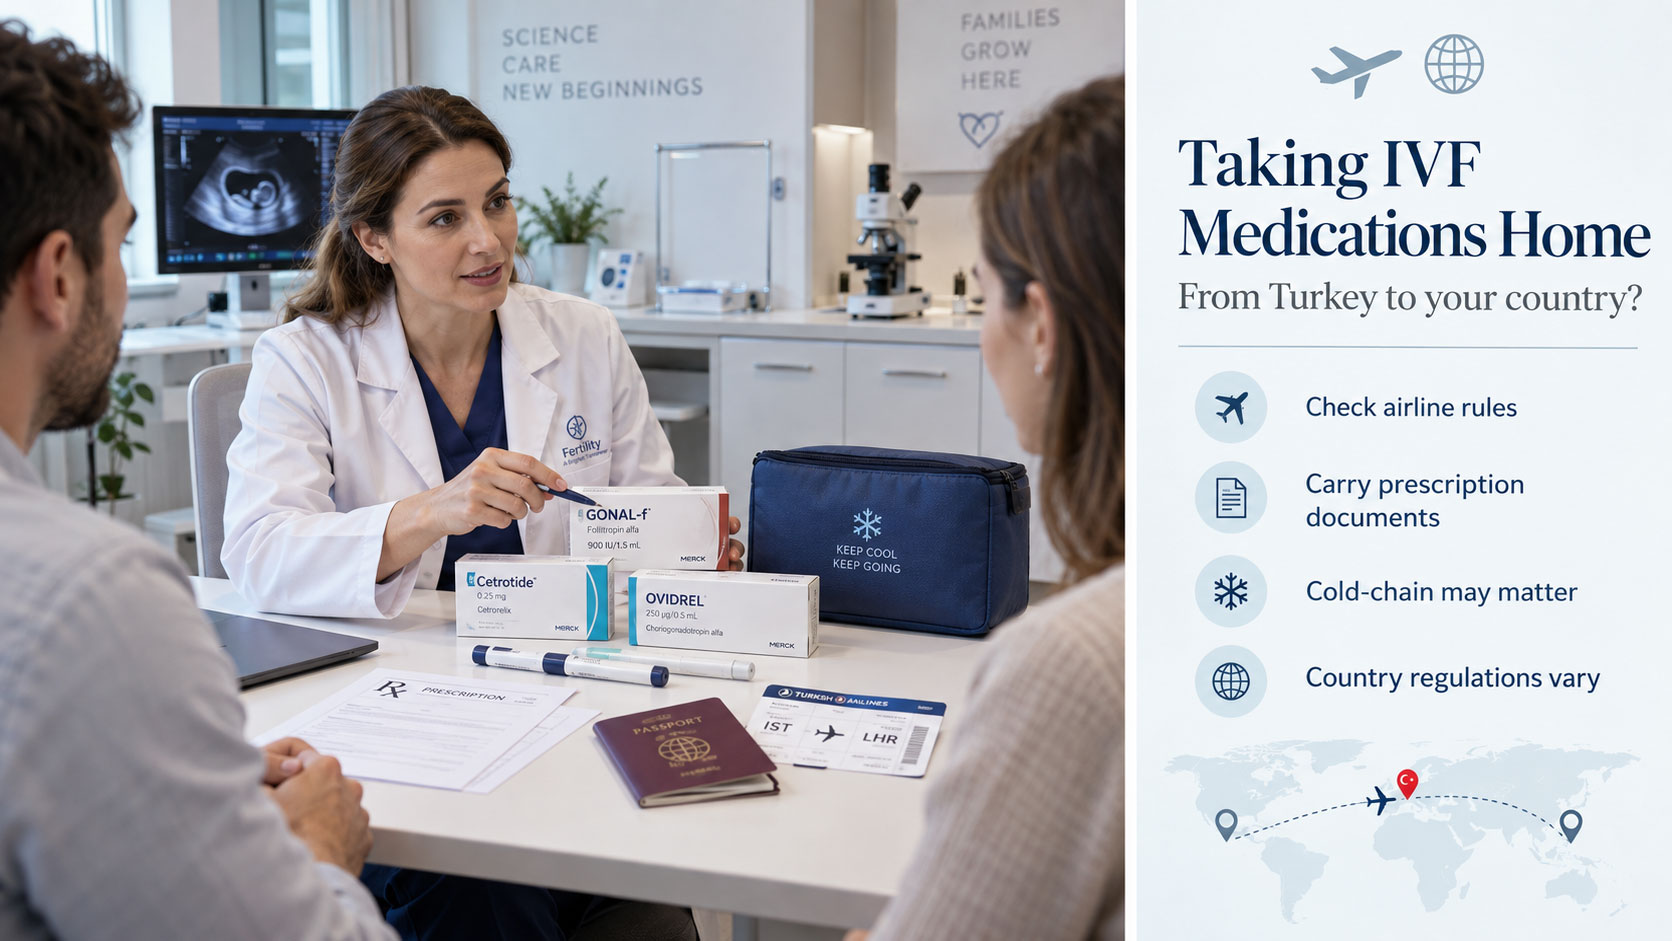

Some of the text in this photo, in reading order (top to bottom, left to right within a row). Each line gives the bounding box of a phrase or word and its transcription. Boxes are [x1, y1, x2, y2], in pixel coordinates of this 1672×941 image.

[961, 8, 1060, 31] FAMILIES
[502, 24, 599, 47] SCIENCE
[961, 39, 1032, 61] GROW
[502, 54, 562, 74] CARE
[961, 69, 1021, 90] HERE
[503, 77, 704, 101] NEW BEGINNINGS
[562, 440, 601, 458] Fertility
[626, 525, 640, 534] alfa
[587, 541, 641, 550] 900 IU/1.5 mL
[836, 544, 898, 560] KEEP COOL
[833, 558, 901, 574] KEEP GOING
[476, 575, 534, 588] Cetrotide
[645, 592, 705, 607] OVIDREL
[477, 605, 512, 614] Cetrorelix
[646, 609, 660, 618] 250
[686, 611, 698, 620] mL
[711, 628, 724, 637] alfa
[769, 641, 795, 649] MERCK
[421, 686, 507, 701] PRESCRIPTION
[632, 716, 703, 735] PASSPORT
[763, 721, 793, 732] IST
[863, 732, 899, 745] LHR
